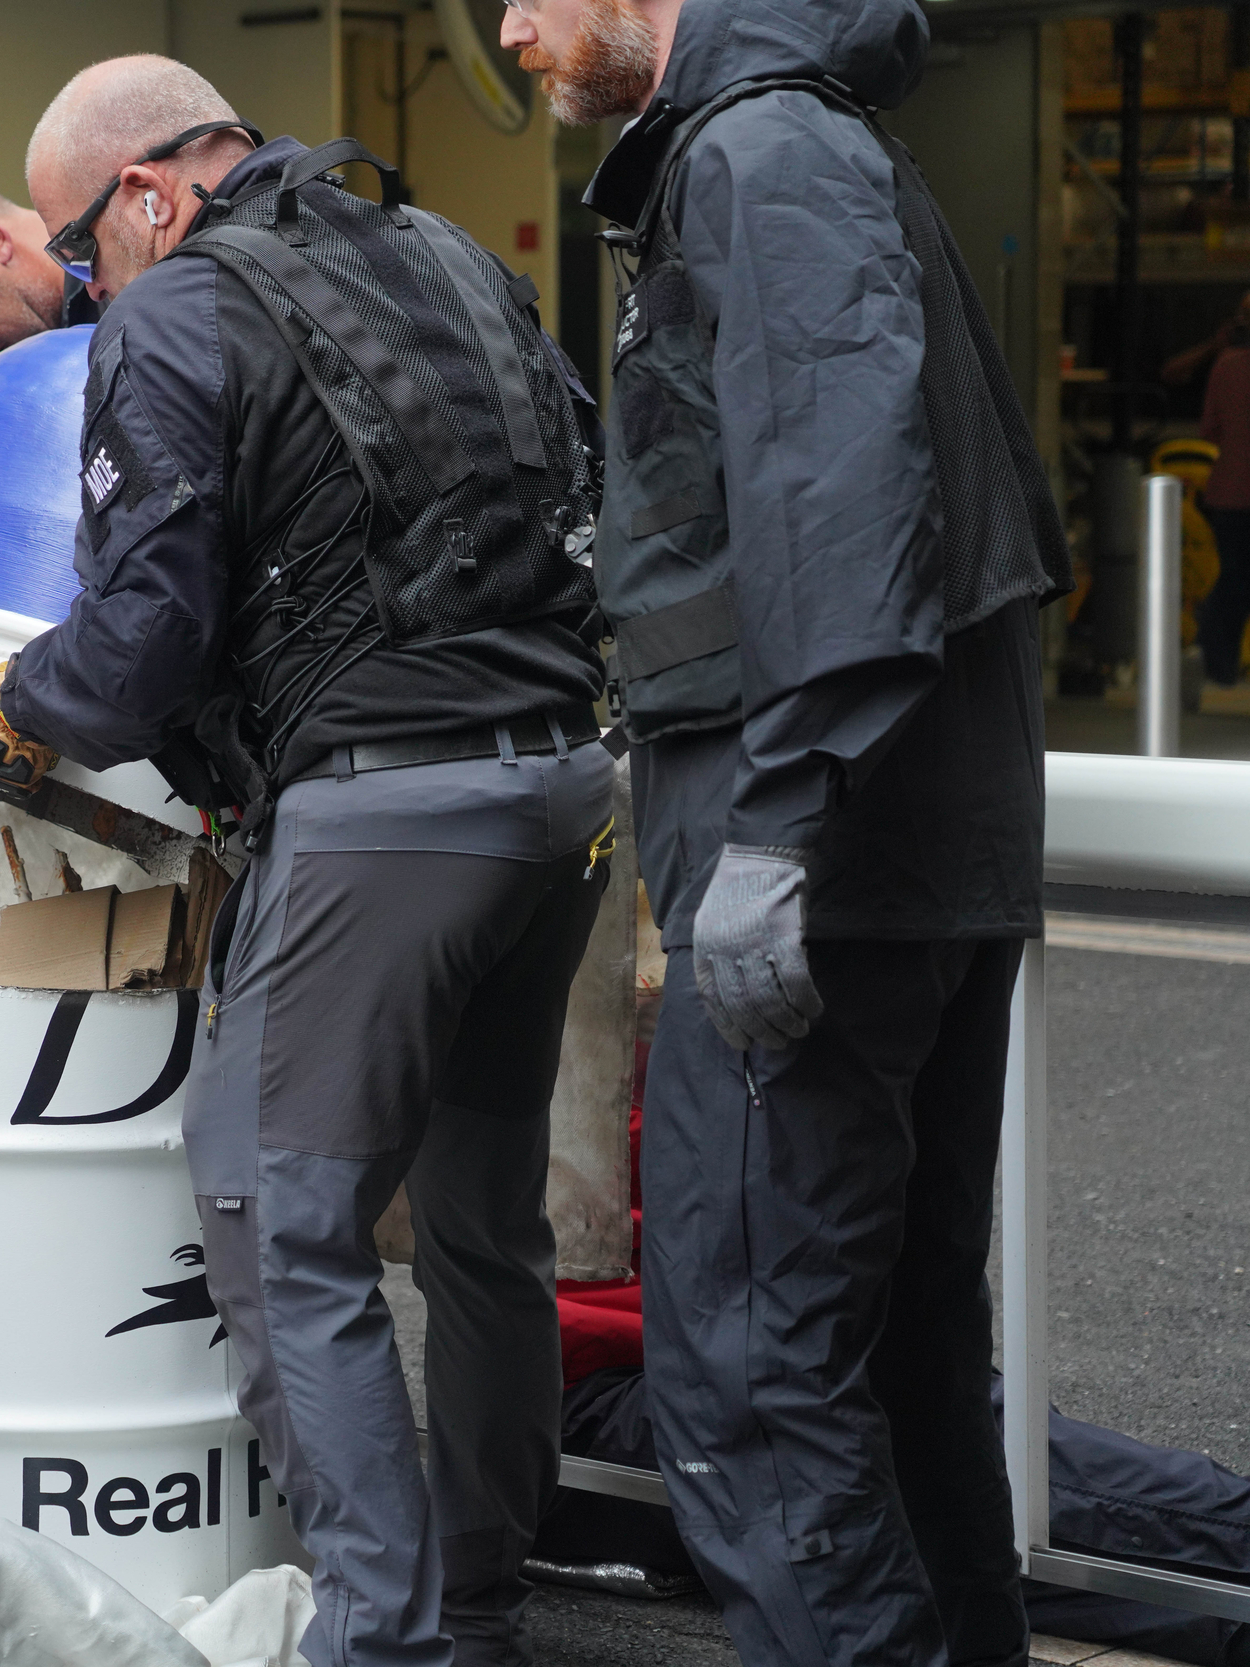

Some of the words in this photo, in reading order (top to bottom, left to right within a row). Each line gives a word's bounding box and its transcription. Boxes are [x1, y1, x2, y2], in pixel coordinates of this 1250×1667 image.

[84, 446, 120, 505] MOE
[21, 1447, 222, 1537] Real
[685, 1461, 721, 1474] GORE-TE
